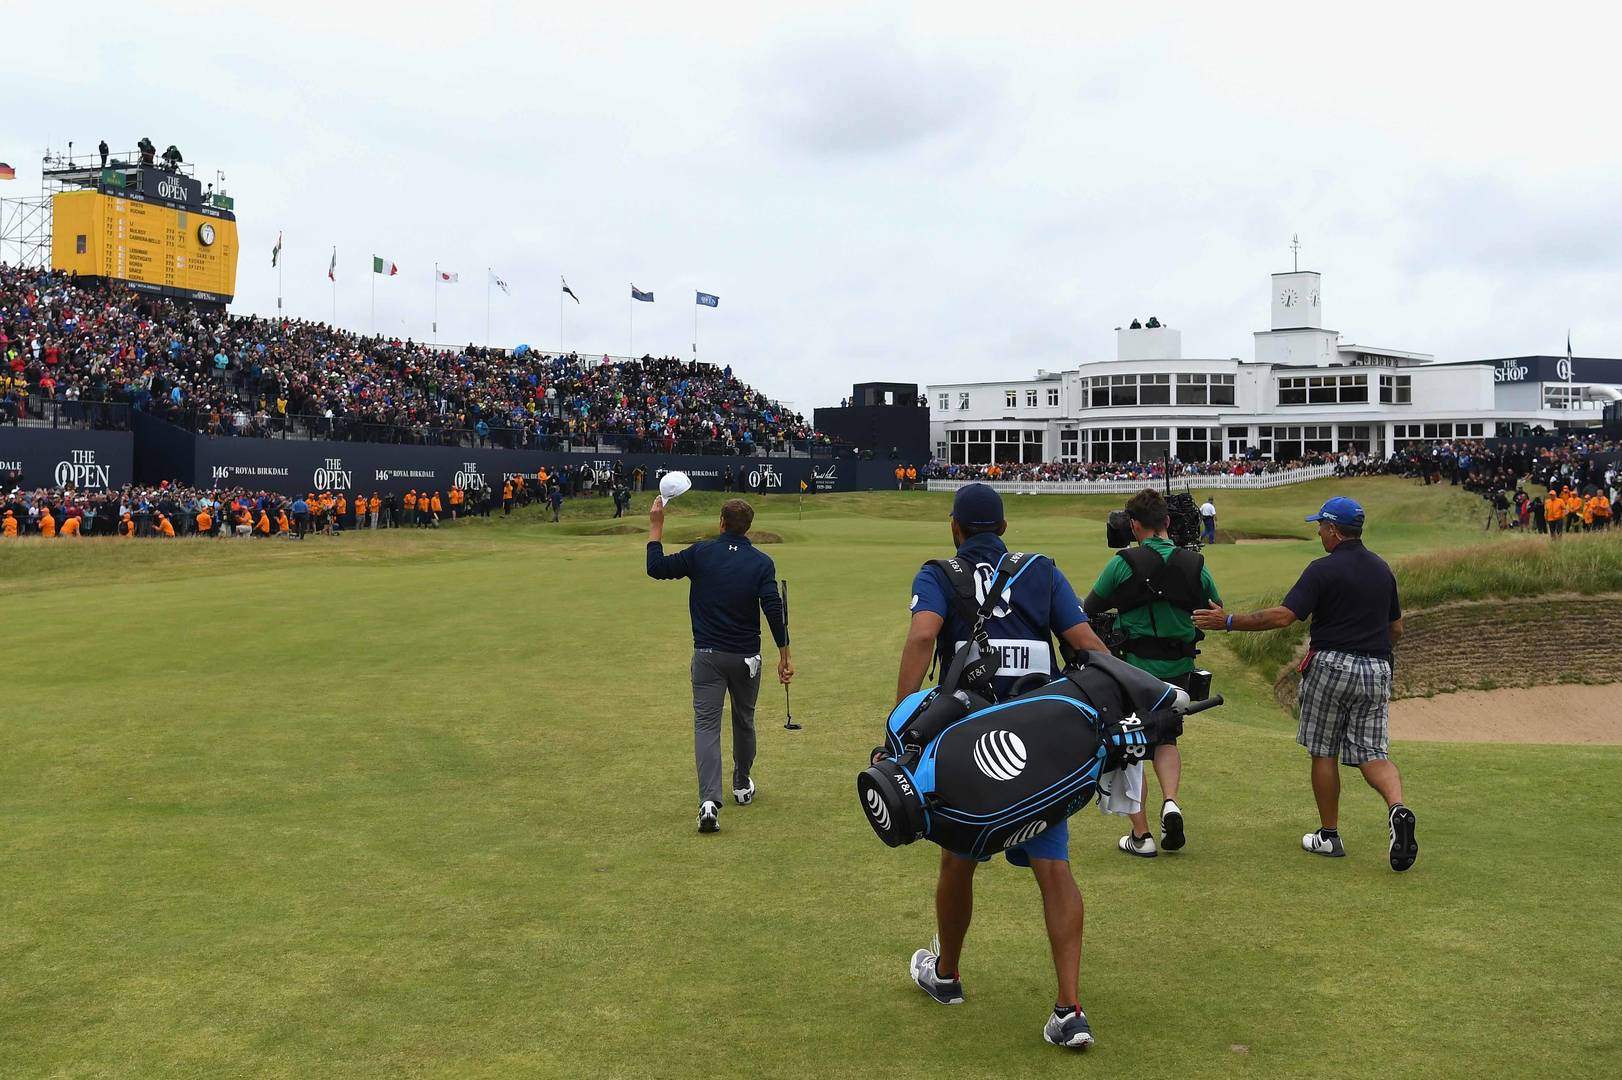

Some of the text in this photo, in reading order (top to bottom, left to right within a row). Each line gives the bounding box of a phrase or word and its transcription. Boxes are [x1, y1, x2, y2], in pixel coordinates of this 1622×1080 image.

[167, 176, 180, 185] THE
[158, 181, 188, 201] OPEN
[1502, 360, 1517, 369] THE
[1494, 366, 1528, 382] SHOP
[72, 450, 95, 464] THE
[325, 458, 342, 470] THE
[0, 461, 22, 470] DALE
[235, 467, 256, 475] ROYAL
[463, 462, 477, 472] THE
[55, 461, 110, 488] OPEN
[314, 468, 352, 490] OPEN
[454, 471, 485, 490] OPEN
[749, 471, 782, 487] OEN
[991, 645, 1030, 670] IETH
[967, 664, 987, 683] AT&T
[894, 774, 914, 796] AT&T
